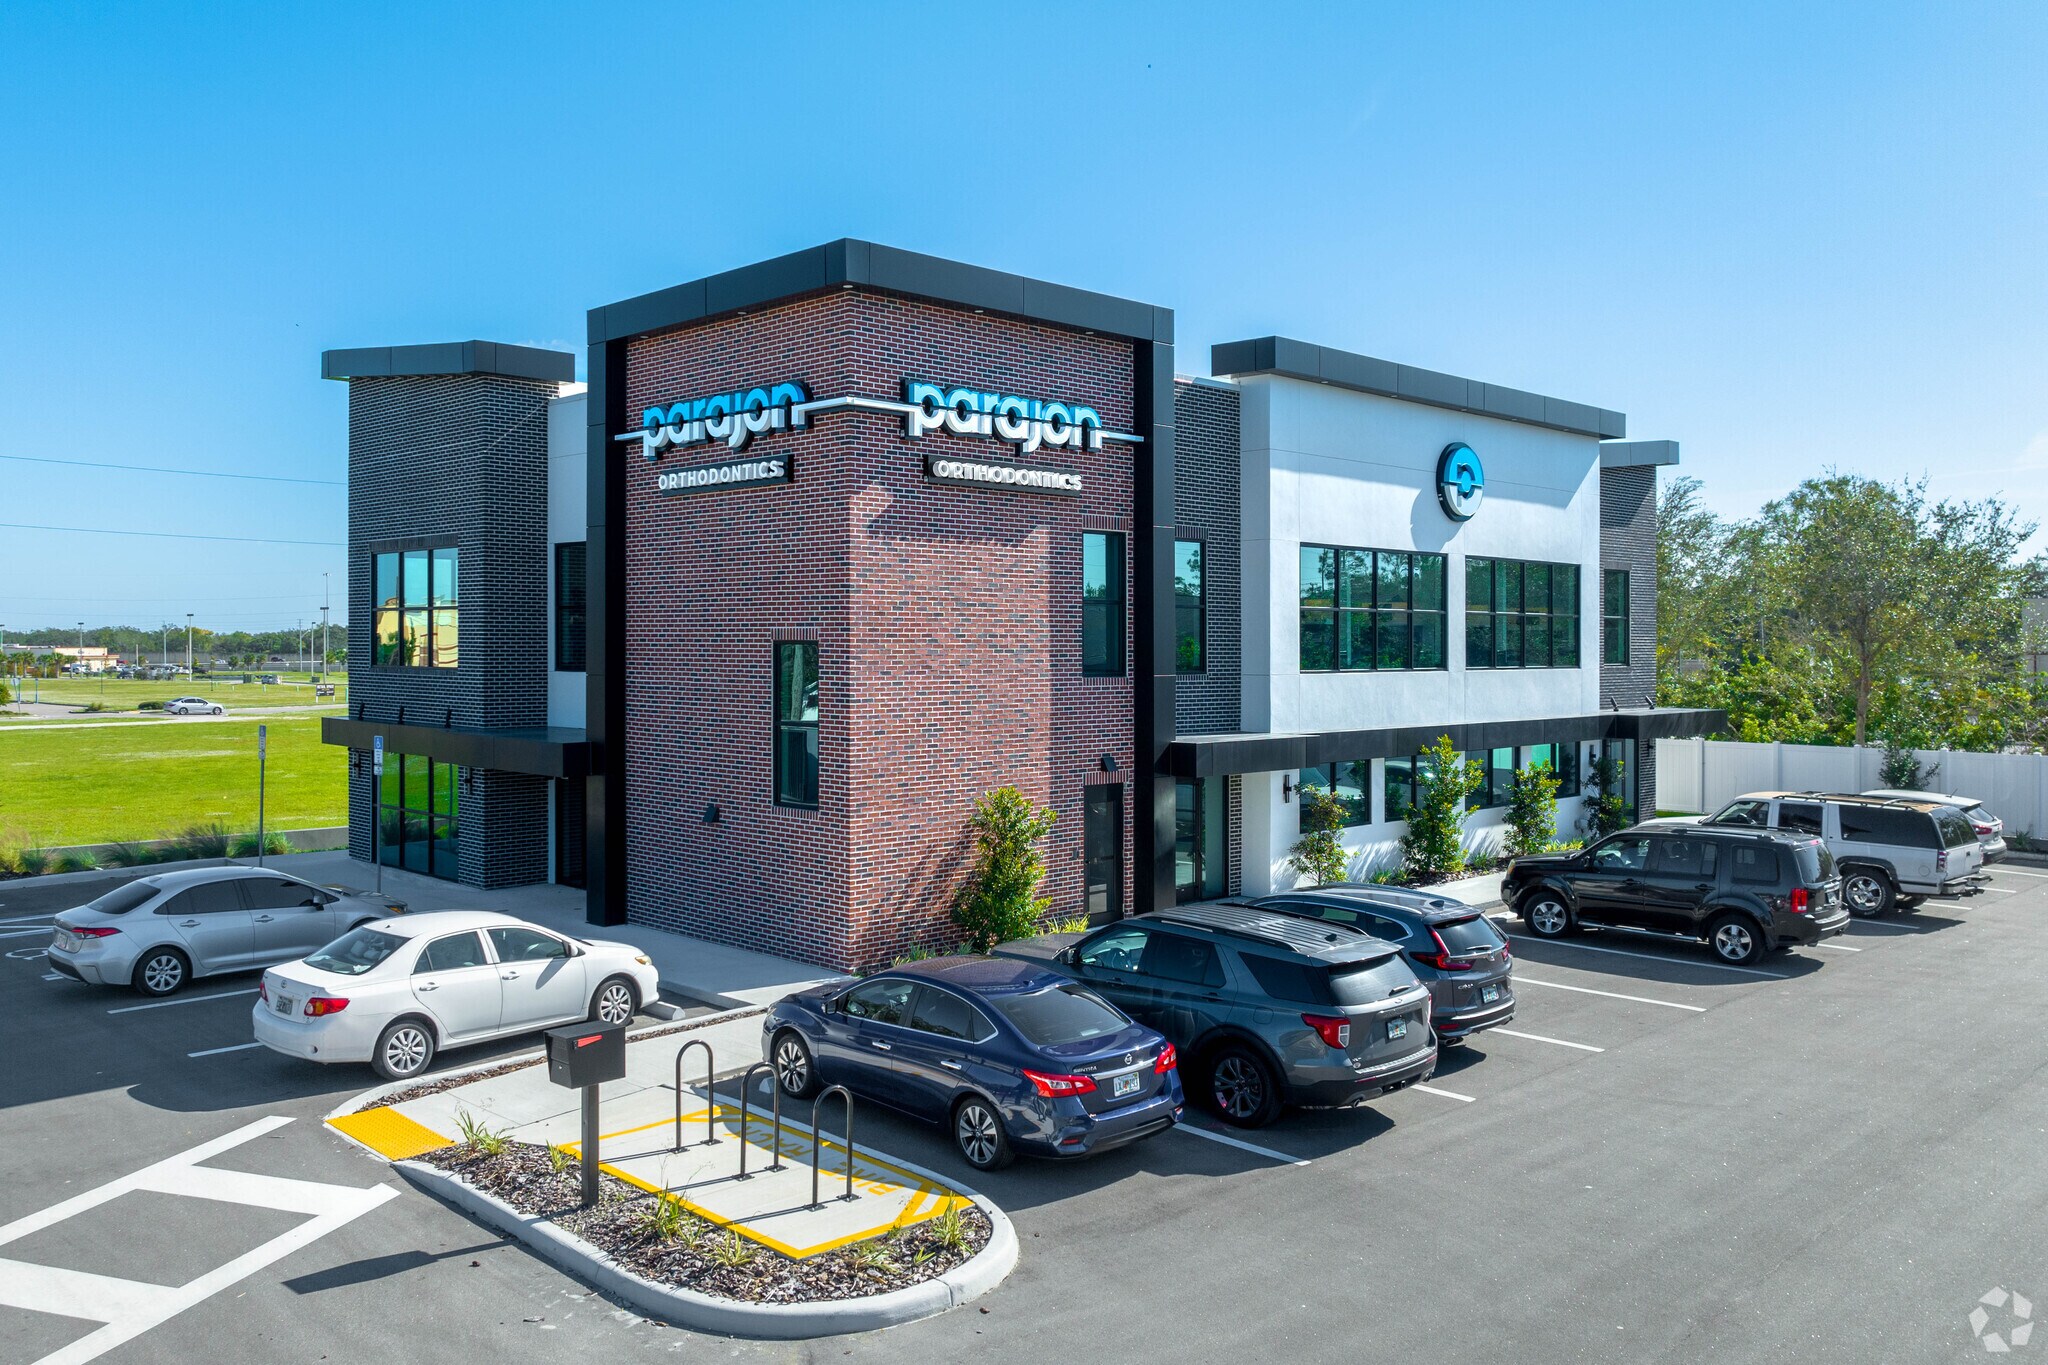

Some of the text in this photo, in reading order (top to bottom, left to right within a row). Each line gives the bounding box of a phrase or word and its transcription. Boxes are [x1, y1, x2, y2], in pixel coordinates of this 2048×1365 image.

[643, 382, 805, 457] parajon
[909, 382, 1102, 453] parajon
[658, 460, 784, 490] ORTHODONTICS
[933, 460, 1082, 490] ORTHODONTICS
